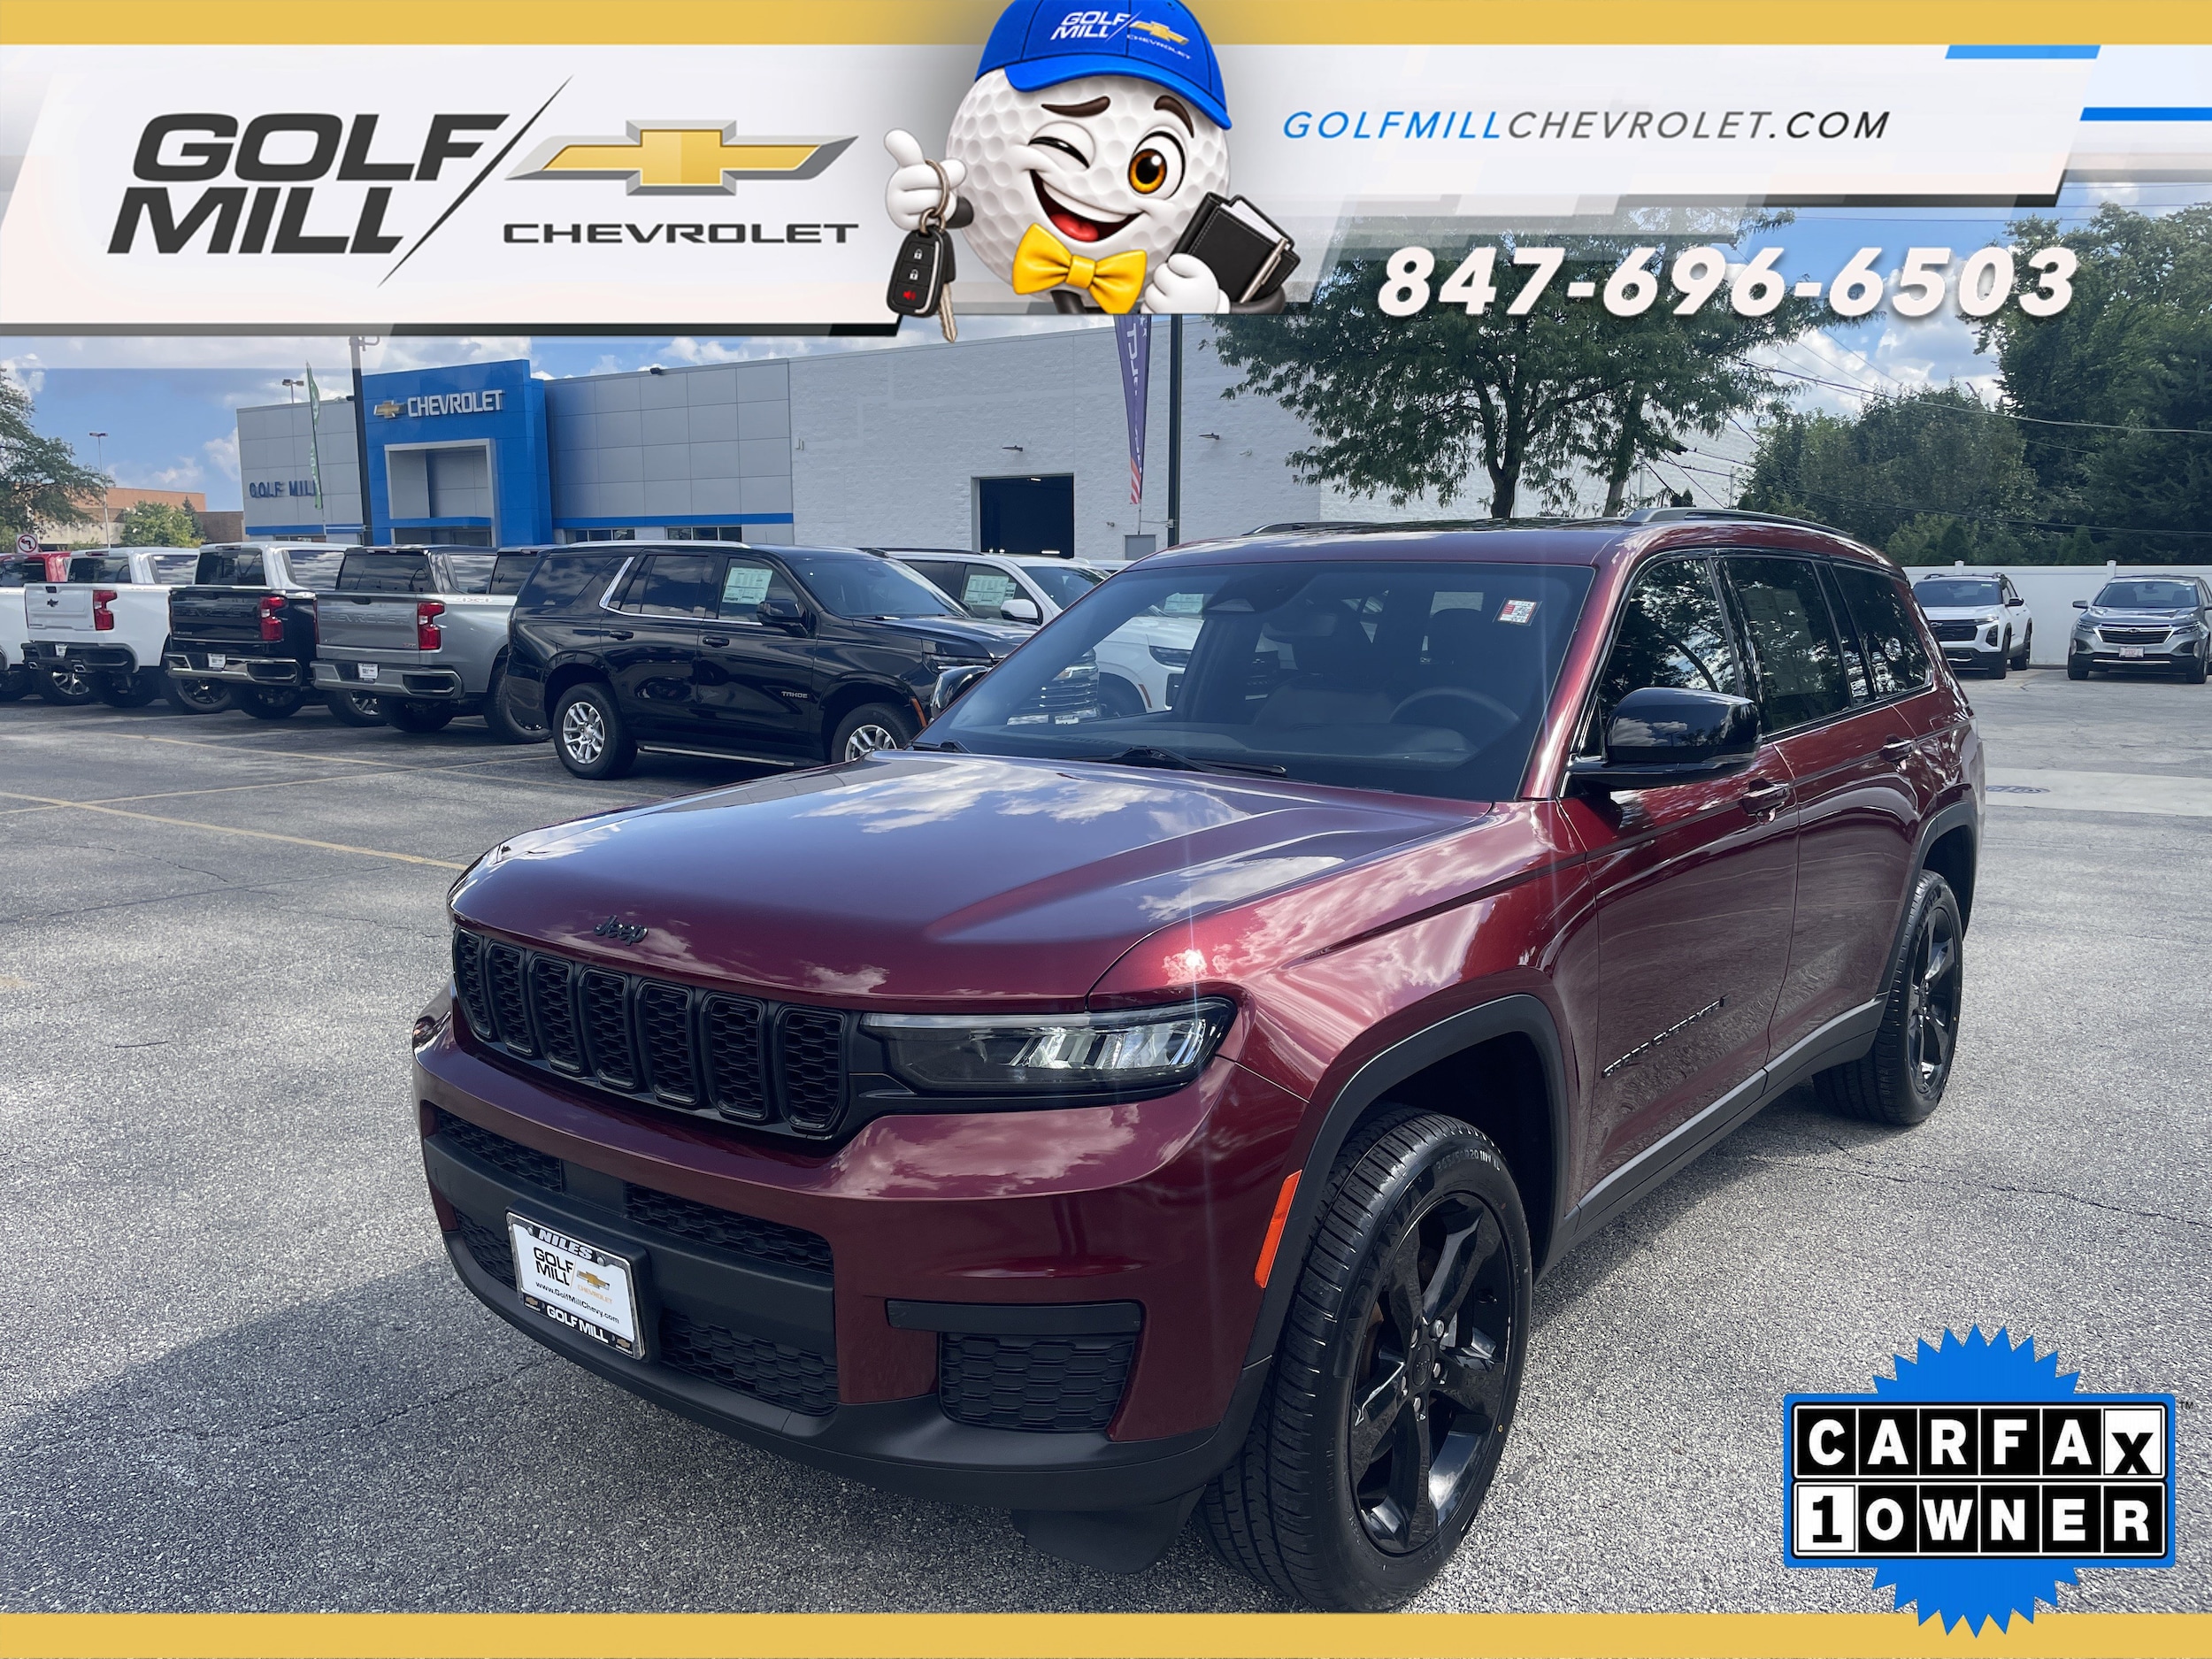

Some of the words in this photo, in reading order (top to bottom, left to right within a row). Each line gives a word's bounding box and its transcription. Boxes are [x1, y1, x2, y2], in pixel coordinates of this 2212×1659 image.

[407, 389, 503, 418] CHEVROLET
[250, 481, 284, 498] GOLF
[594, 915, 649, 946] Jeep
[538, 1229, 594, 1260] NILES
[533, 1247, 574, 1273] GOLF
[535, 1261, 571, 1286] MILL
[535, 1281, 620, 1325] www.GolfMillChevy.com
[547, 1305, 579, 1328] GOLF
[579, 1320, 610, 1344] MILL
